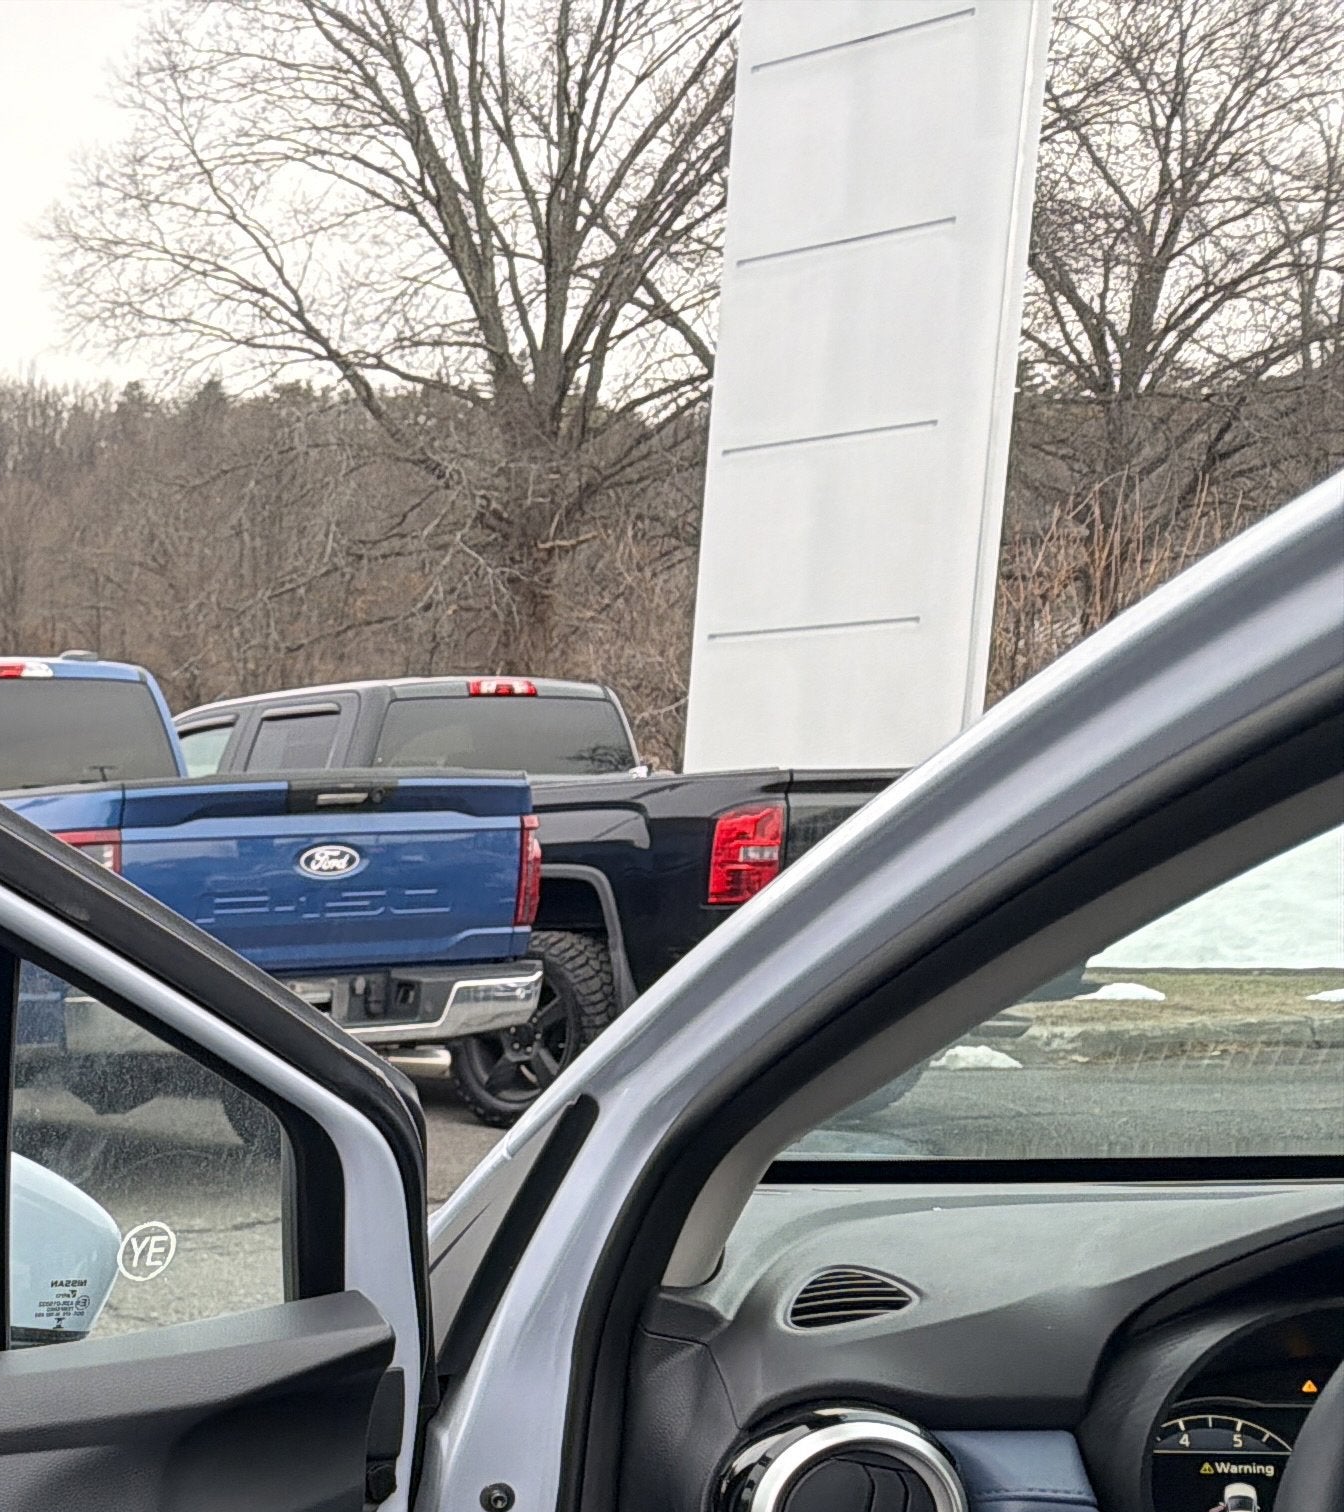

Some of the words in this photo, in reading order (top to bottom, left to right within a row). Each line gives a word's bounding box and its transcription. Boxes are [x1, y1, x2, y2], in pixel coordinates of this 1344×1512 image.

[311, 850, 350, 871] Ford
[131, 1235, 169, 1268] YE
[1179, 1434, 1191, 1448] 4
[1233, 1434, 1244, 1448] 5
[1214, 1461, 1275, 1477] Warning
